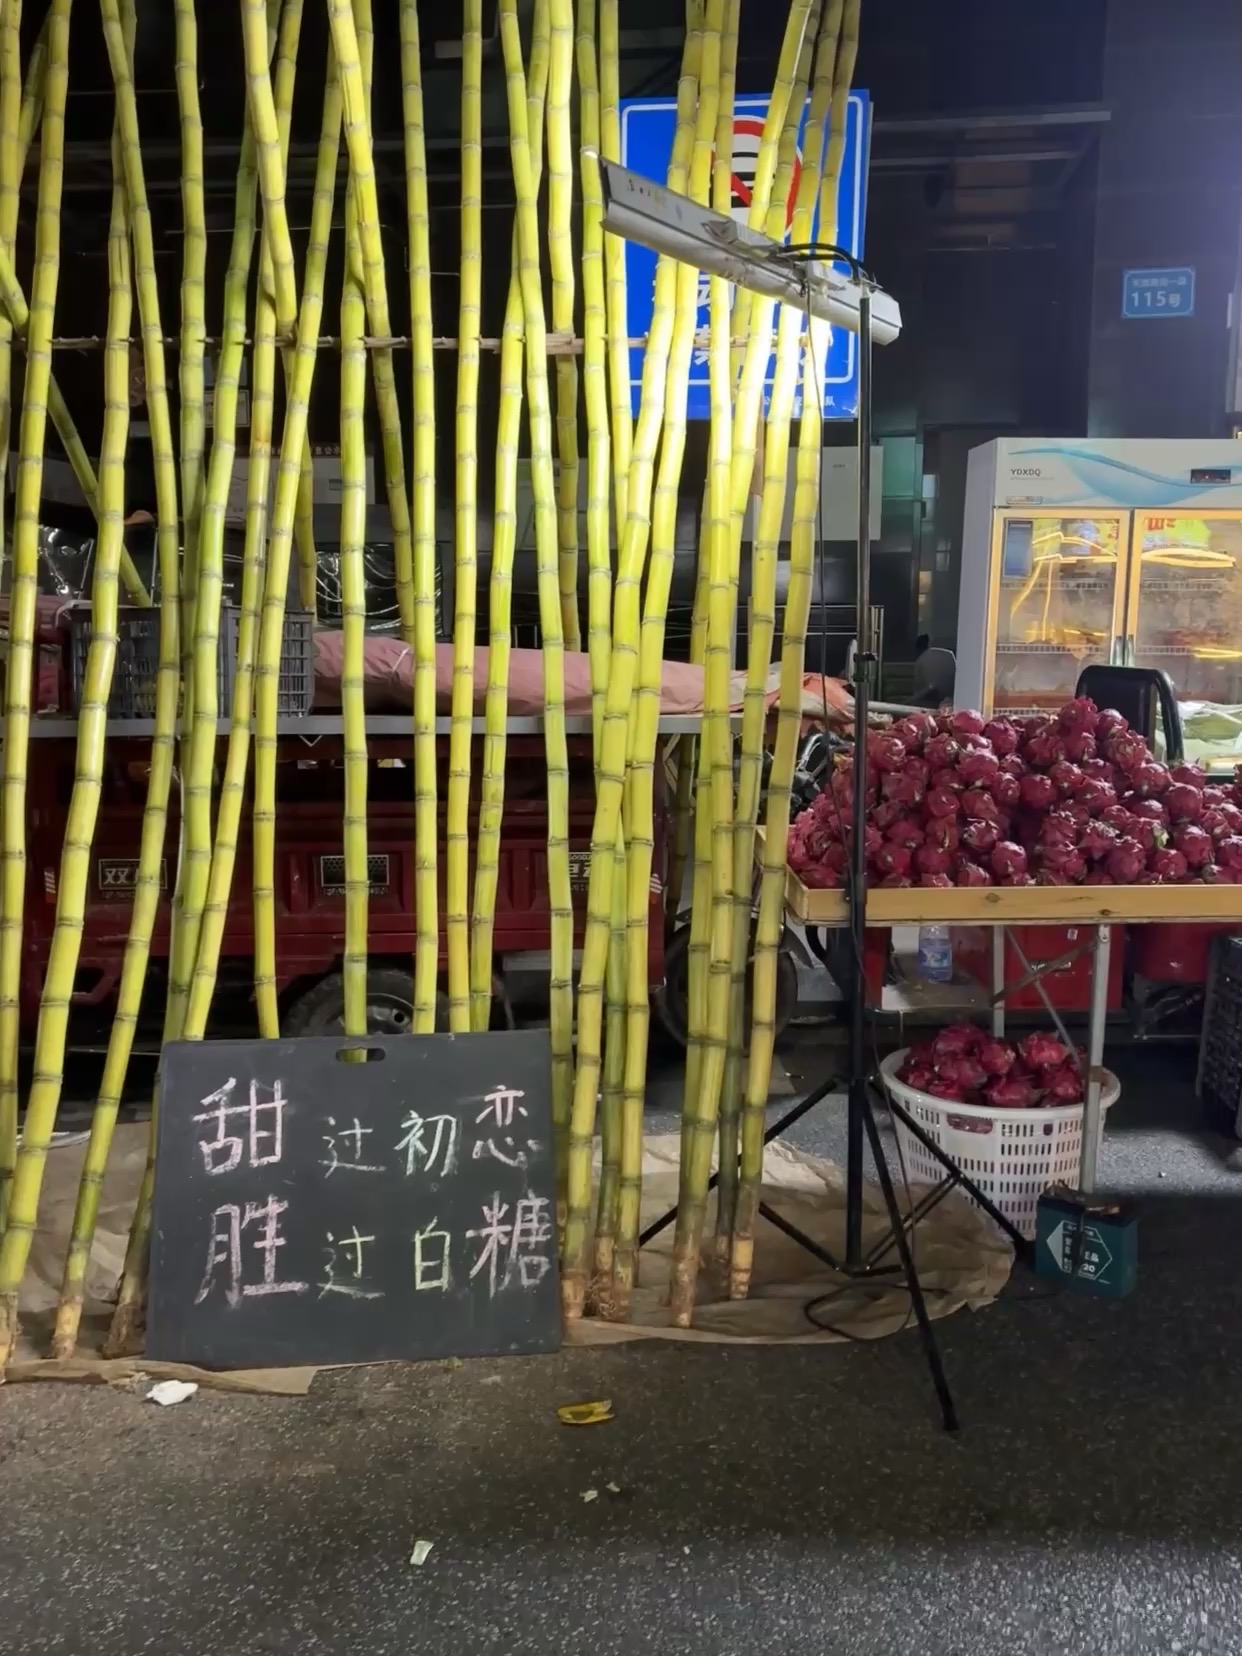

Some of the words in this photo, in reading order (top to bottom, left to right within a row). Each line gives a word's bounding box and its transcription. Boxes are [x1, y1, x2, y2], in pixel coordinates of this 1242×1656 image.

[193, 1077, 542, 1179] 甜过初恋
[194, 1191, 552, 1311] 胜过白糖
